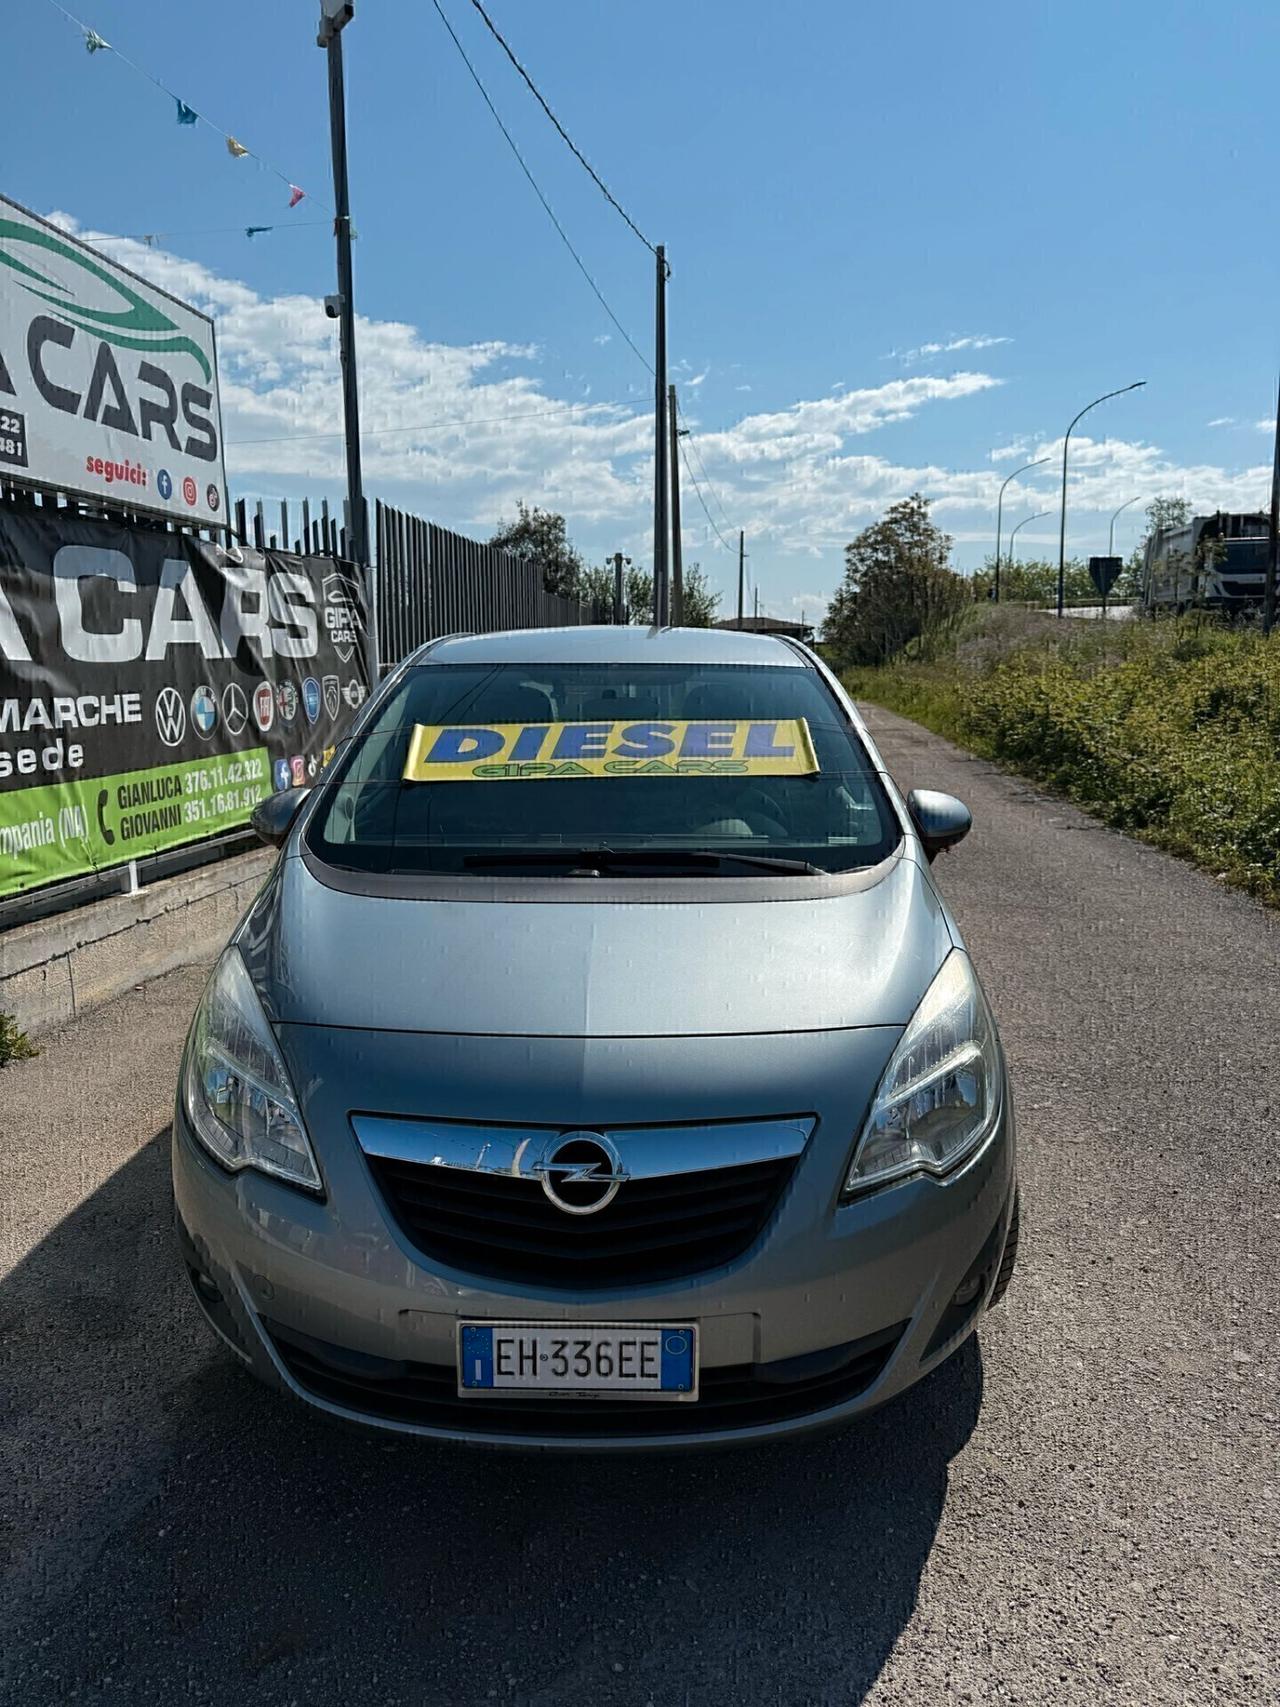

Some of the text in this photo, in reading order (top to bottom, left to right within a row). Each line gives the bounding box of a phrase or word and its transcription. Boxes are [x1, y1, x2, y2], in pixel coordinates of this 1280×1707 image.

[27, 315, 217, 463] CARS
[86, 455, 147, 487] seguici:
[53, 545, 319, 663] CARS
[424, 723, 796, 763] DIESEL
[472, 759, 750, 778] GIPA CARS
[117, 775, 182, 810] GIANLUCA
[58, 803, 89, 848] (NA)
[120, 804, 182, 841] GIOVANNI
